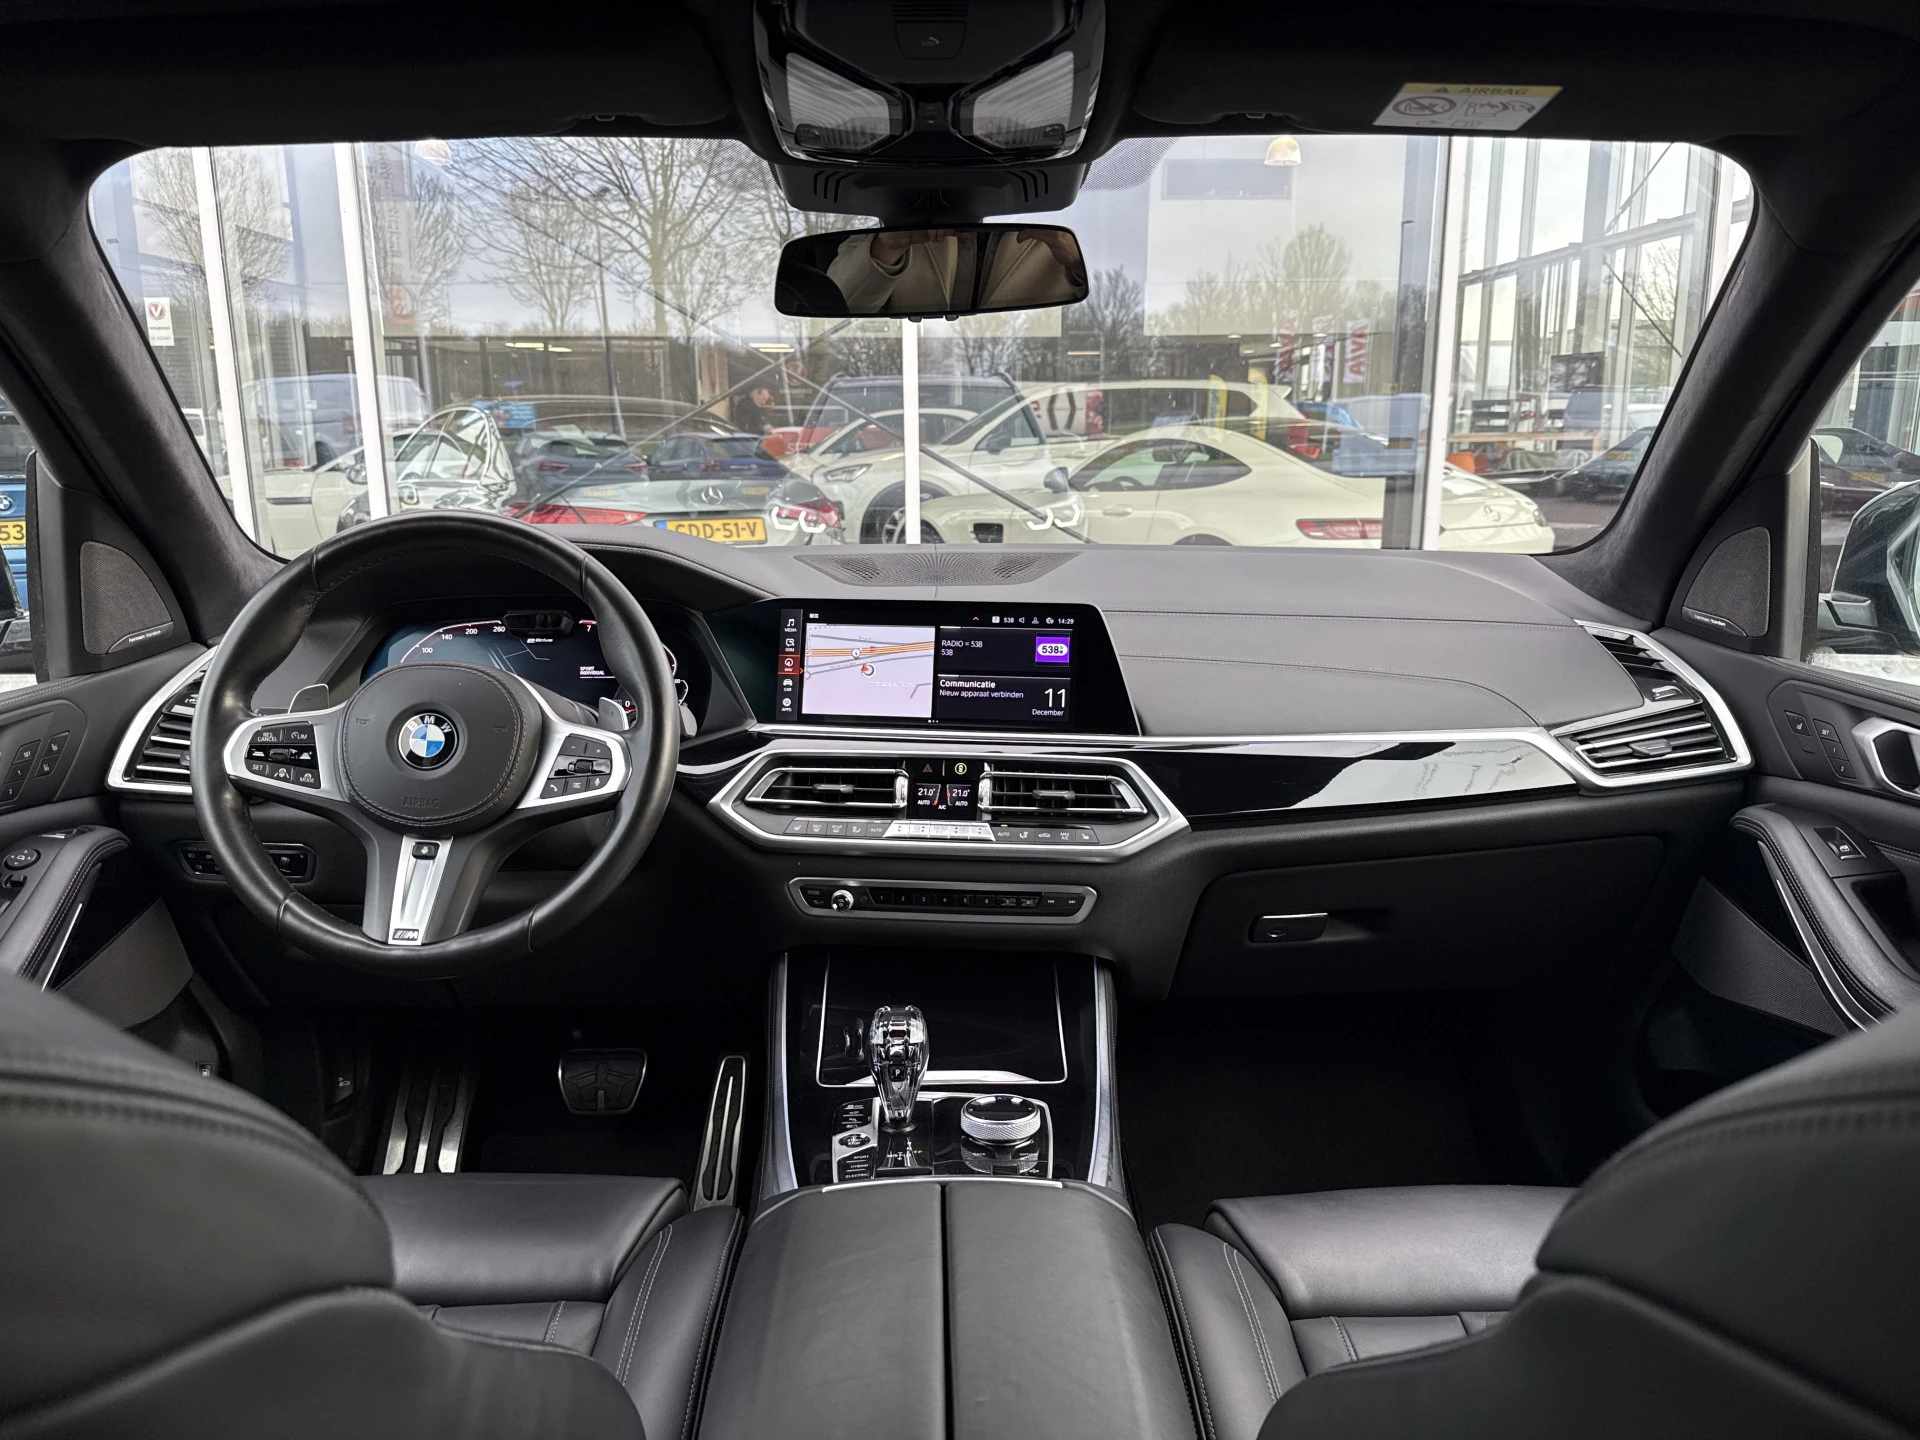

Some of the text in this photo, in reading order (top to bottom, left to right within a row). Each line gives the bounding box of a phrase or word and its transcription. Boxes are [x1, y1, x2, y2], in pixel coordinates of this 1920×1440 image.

[1459, 87, 1528, 95] AIRBAG
[941, 648, 954, 656] 538
[1041, 645, 1059, 654] 538
[940, 679, 996, 688] Communicatie
[960, 690, 990, 698] apparaat
[991, 691, 1024, 699] verbinden
[1044, 688, 1066, 708] 11
[1032, 708, 1064, 716] December
[407, 715, 452, 733] BMW
[402, 797, 440, 809] AIRBAG
